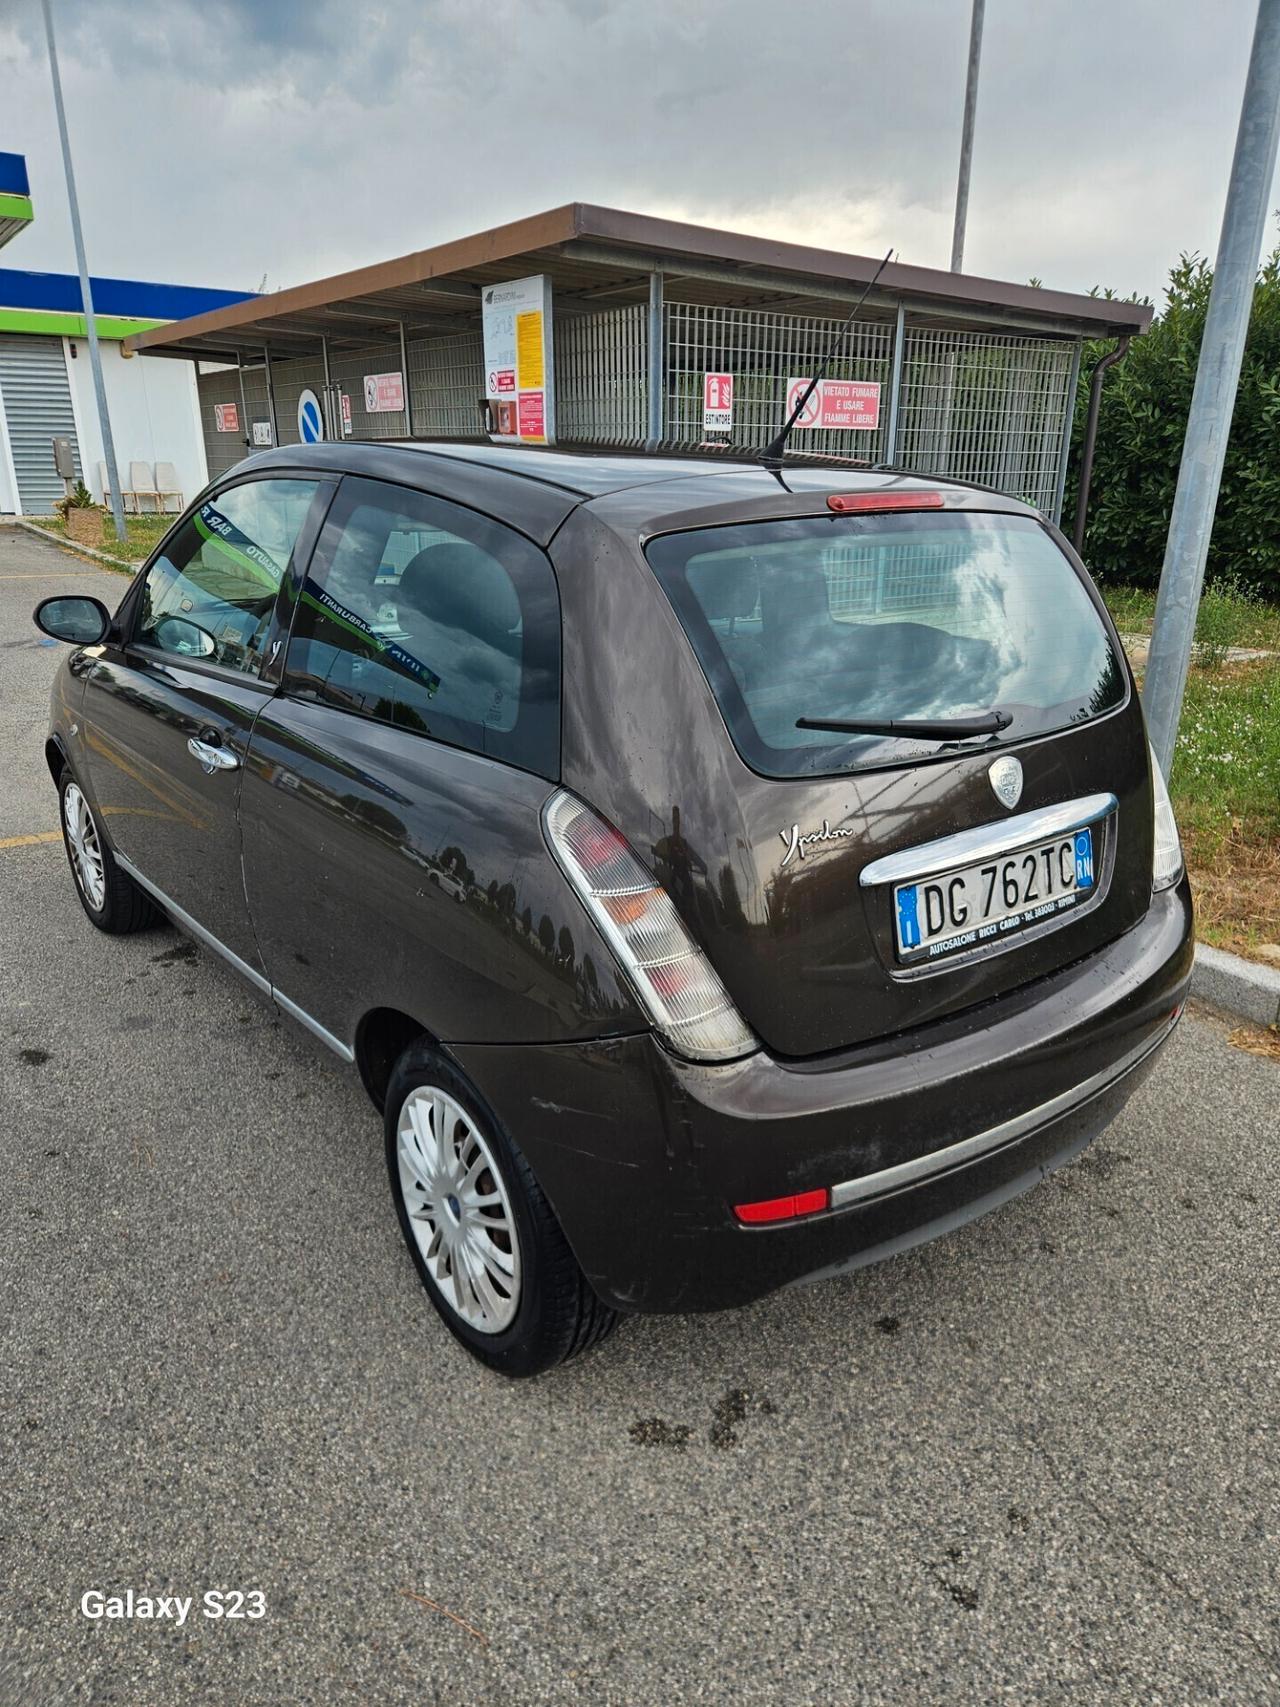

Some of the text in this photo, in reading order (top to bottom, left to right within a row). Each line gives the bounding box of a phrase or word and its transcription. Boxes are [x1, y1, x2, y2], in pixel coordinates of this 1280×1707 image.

[823, 385, 878, 399] VIETATO FUMARE
[836, 399, 865, 411] E USARE
[705, 413, 731, 425] ESTINTORE
[824, 412, 875, 424] FIAMME LIBERE
[780, 819, 853, 867] Ypsilon
[1076, 858, 1090, 880] RN
[923, 841, 1075, 937] DG 762TC
[929, 930, 977, 956] AUTOSALONE
[978, 923, 998, 939] RICCI
[999, 915, 1021, 930] CARLO
